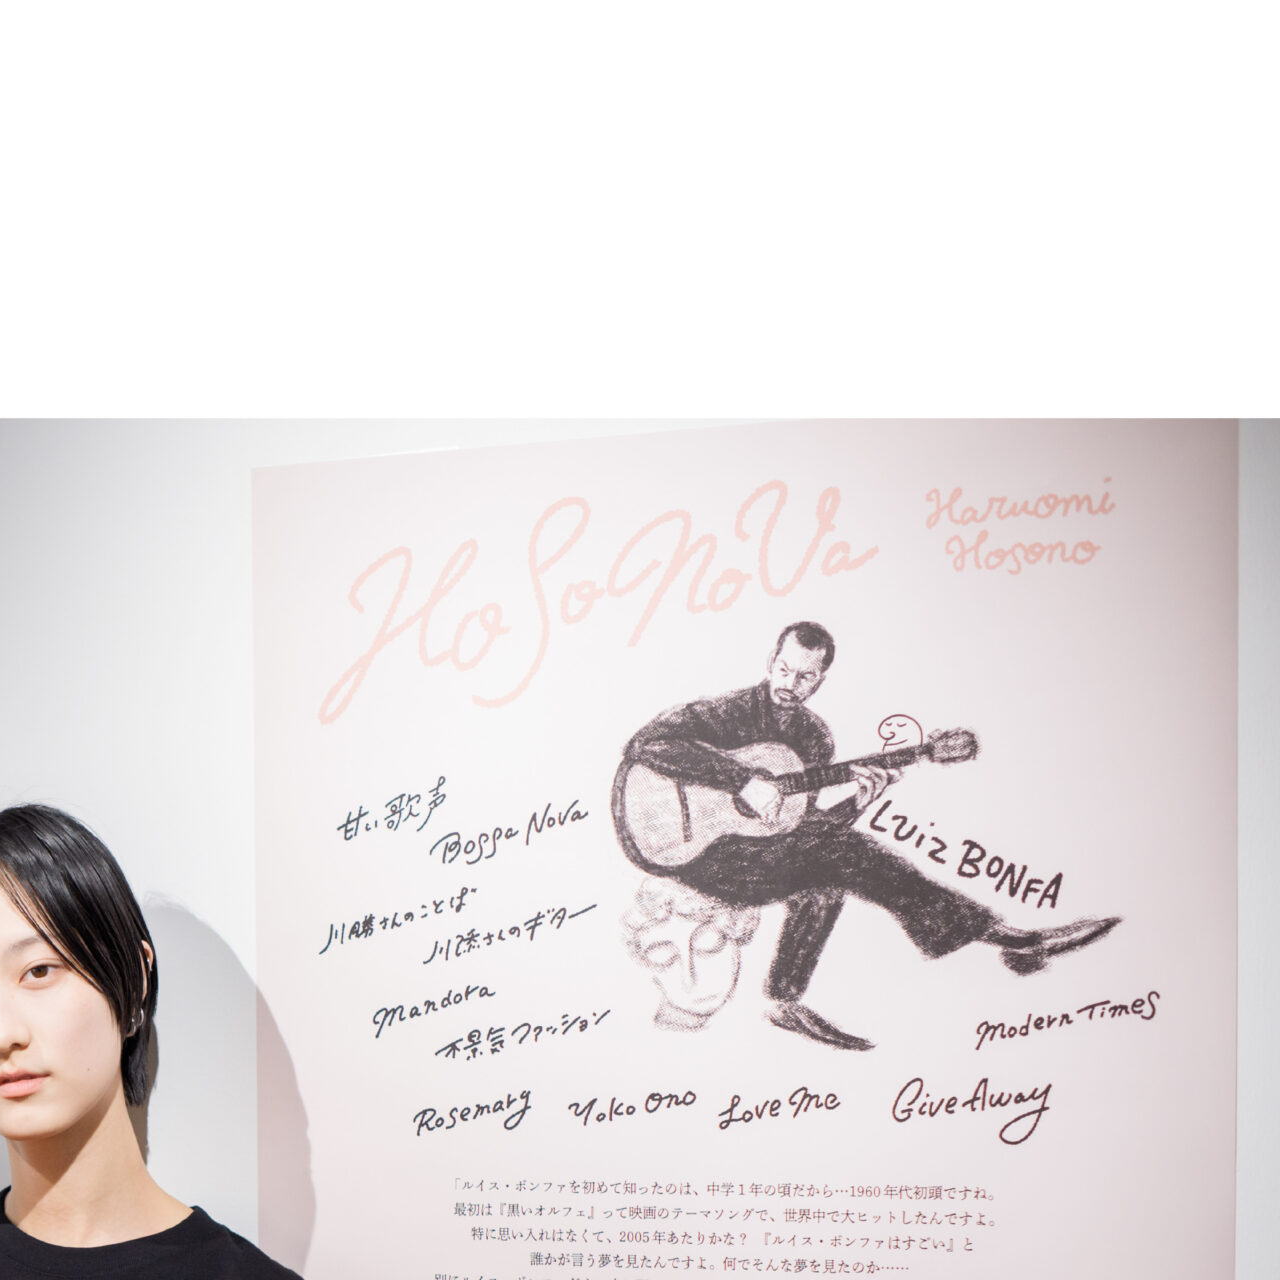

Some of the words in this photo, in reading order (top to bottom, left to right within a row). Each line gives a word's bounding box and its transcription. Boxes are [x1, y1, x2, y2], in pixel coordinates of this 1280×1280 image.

[925, 476, 1116, 529] Haruomi
[945, 530, 1101, 575] Hosono
[337, 776, 446, 841] 甘い歌声
[429, 827, 519, 865] Bossa
[957, 839, 1064, 909] BONFA
[319, 887, 477, 955] 川勝さんのことば
[423, 904, 597, 964] 川添さんのギター
[435, 1009, 611, 1061] 不景気ファッション
[413, 1090, 532, 1136] Rosemary
[719, 1094, 781, 1130] Love
[893, 1077, 959, 1123] Give
[962, 1077, 1052, 1146] Away
